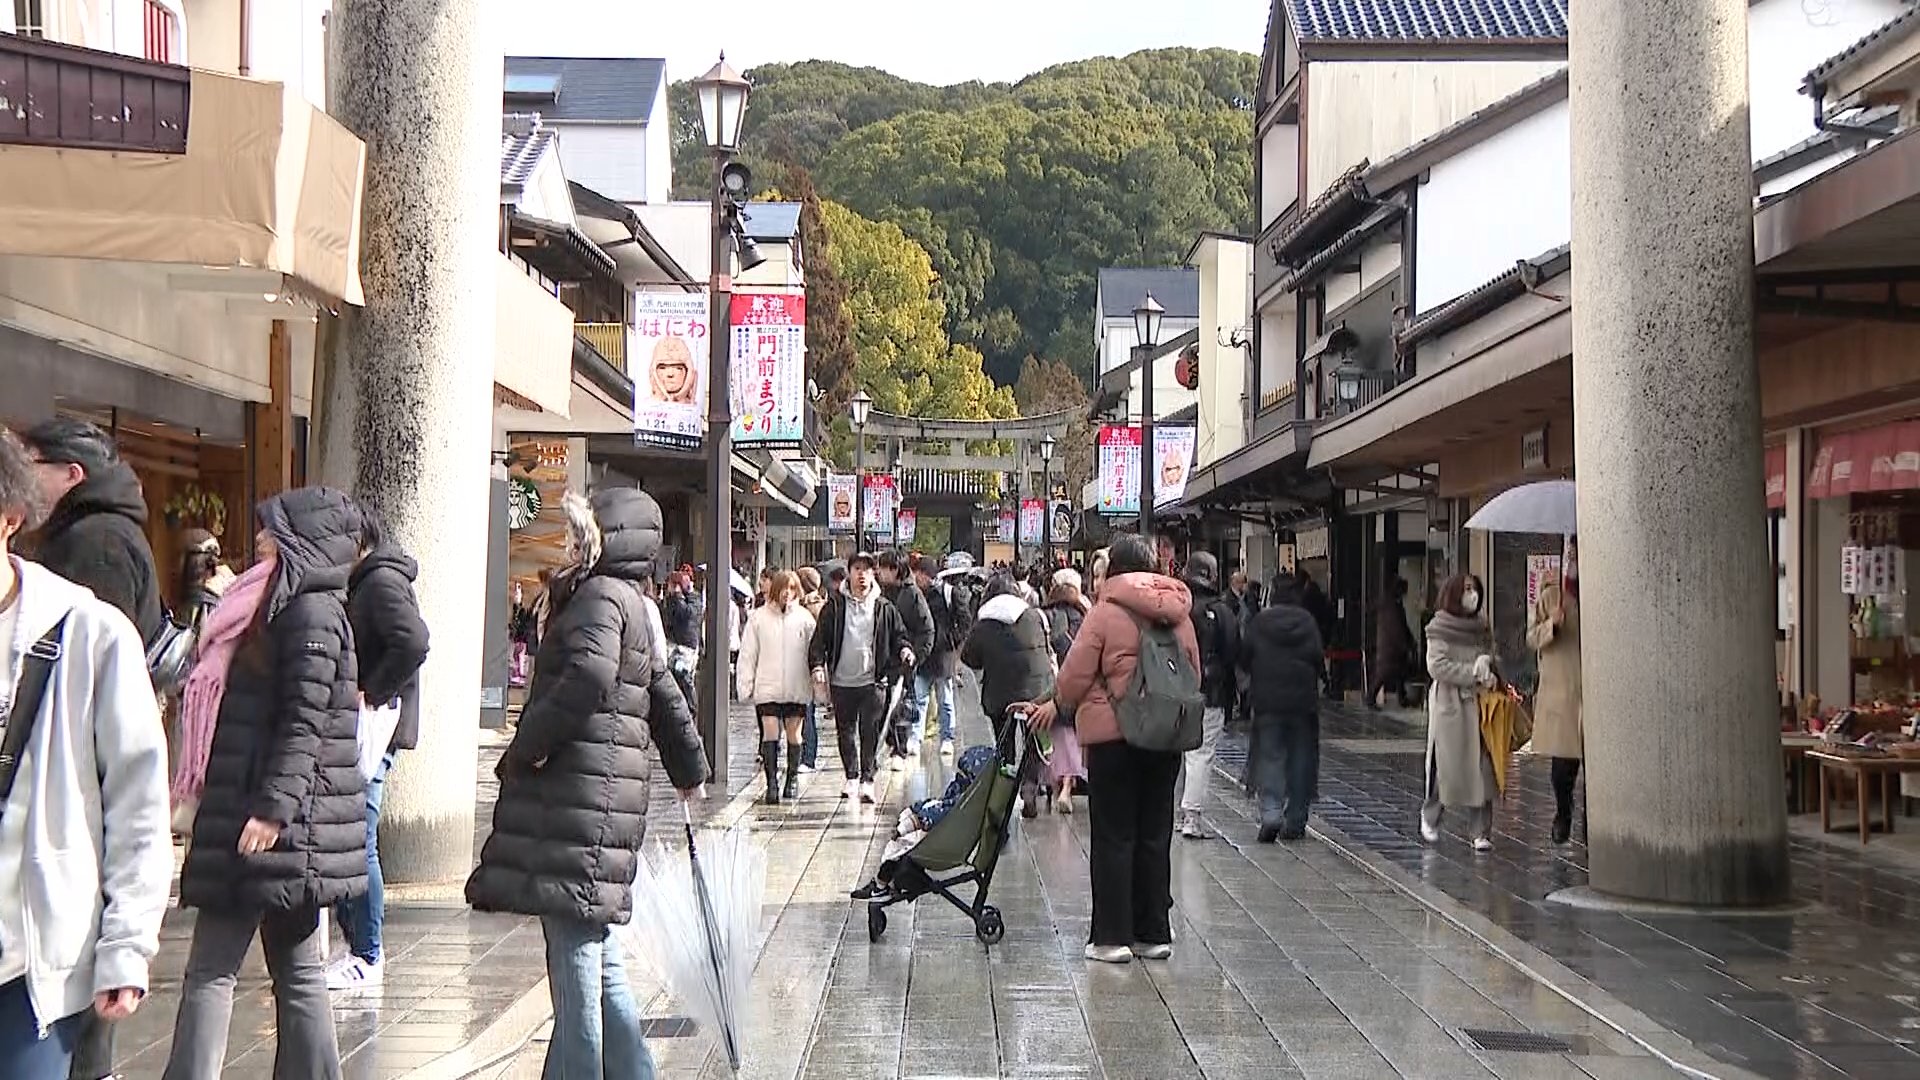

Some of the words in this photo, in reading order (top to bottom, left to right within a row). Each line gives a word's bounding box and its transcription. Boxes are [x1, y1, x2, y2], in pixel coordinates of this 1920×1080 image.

[642, 318, 706, 338] はにわ
[757, 334, 776, 434] 門前まつり
